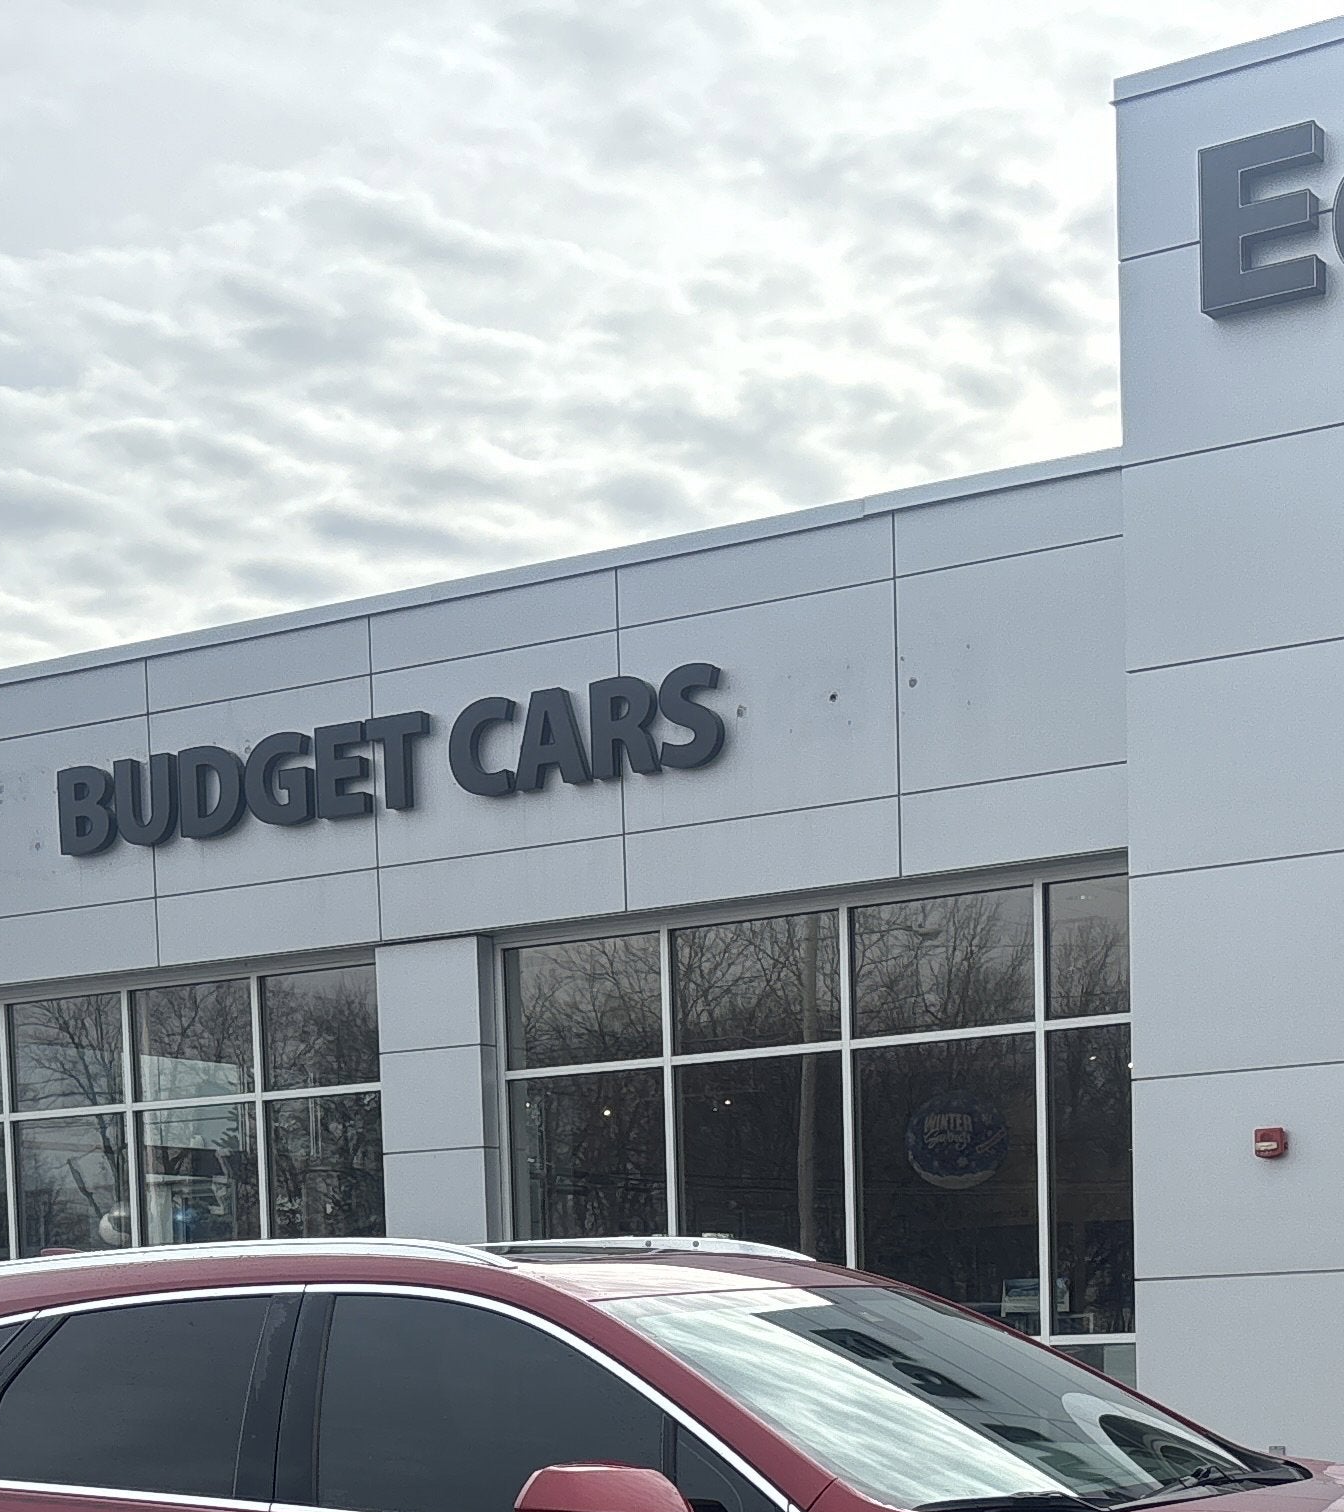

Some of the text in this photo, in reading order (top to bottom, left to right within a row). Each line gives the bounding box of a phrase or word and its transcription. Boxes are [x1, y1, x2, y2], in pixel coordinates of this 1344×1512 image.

[57, 662, 726, 857] BUDGET CARS
[923, 1112, 973, 1132] WINTER
